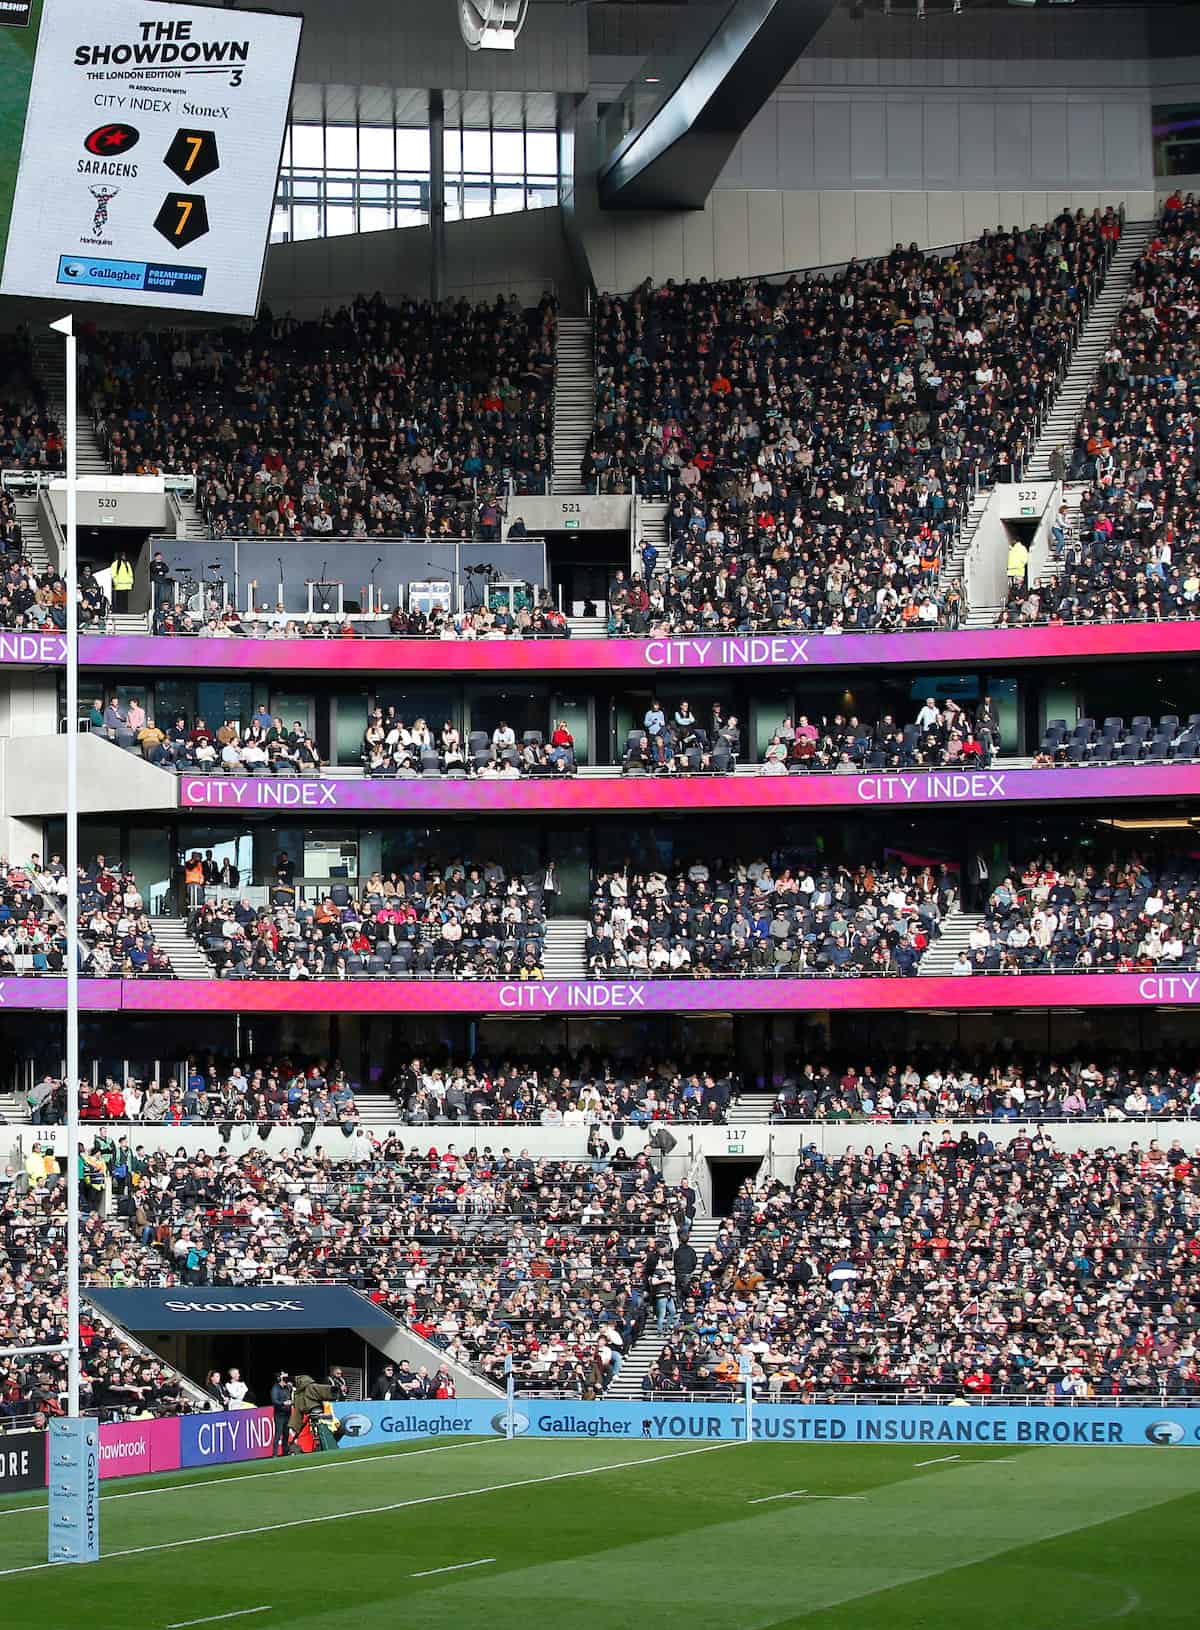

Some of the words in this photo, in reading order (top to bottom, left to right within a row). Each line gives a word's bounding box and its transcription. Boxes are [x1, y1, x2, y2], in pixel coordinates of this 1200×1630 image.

[139, 21, 192, 41] THE
[74, 41, 249, 66] SHOWDOWN
[87, 72, 104, 80] THE
[106, 71, 144, 80] LONDON
[145, 70, 181, 79] EDITION
[229, 70, 243, 87] 3
[94, 94, 126, 107] CITY
[130, 98, 171, 112] INDEX
[182, 102, 231, 119] StoneX
[184, 137, 202, 171] 7
[77, 160, 138, 178] SARACENS
[175, 202, 193, 235] 7
[89, 266, 142, 282] Gallagher
[98, 498, 117, 508] 520
[1018, 491, 1037, 500] 522
[562, 504, 581, 512] 521
[645, 642, 711, 664] CITY
[720, 639, 809, 662] INDEX
[187, 781, 248, 802] CITY
[257, 783, 337, 805] INDEX
[858, 777, 918, 799] CITY
[927, 776, 1006, 798] INDEX
[500, 984, 558, 1006] CITY
[568, 984, 645, 1006] INDEX
[1140, 977, 1199, 999] CITY
[37, 1130, 56, 1141] 116
[727, 1130, 746, 1140] 117
[165, 1300, 304, 1313] StoneX
[199, 1420, 239, 1455] CITY
[246, 1416, 275, 1449] IND
[380, 1414, 473, 1435] Gallagher
[538, 1415, 632, 1437] Gallagher
[653, 1416, 721, 1437] YOUR
[731, 1417, 846, 1439] TRUSTED
[857, 1418, 1007, 1441] INSURANCE
[1017, 1421, 1123, 1442] BROKER
[98, 1436, 145, 1459] hawbrook
[87, 1453, 95, 1550] Gallagher
